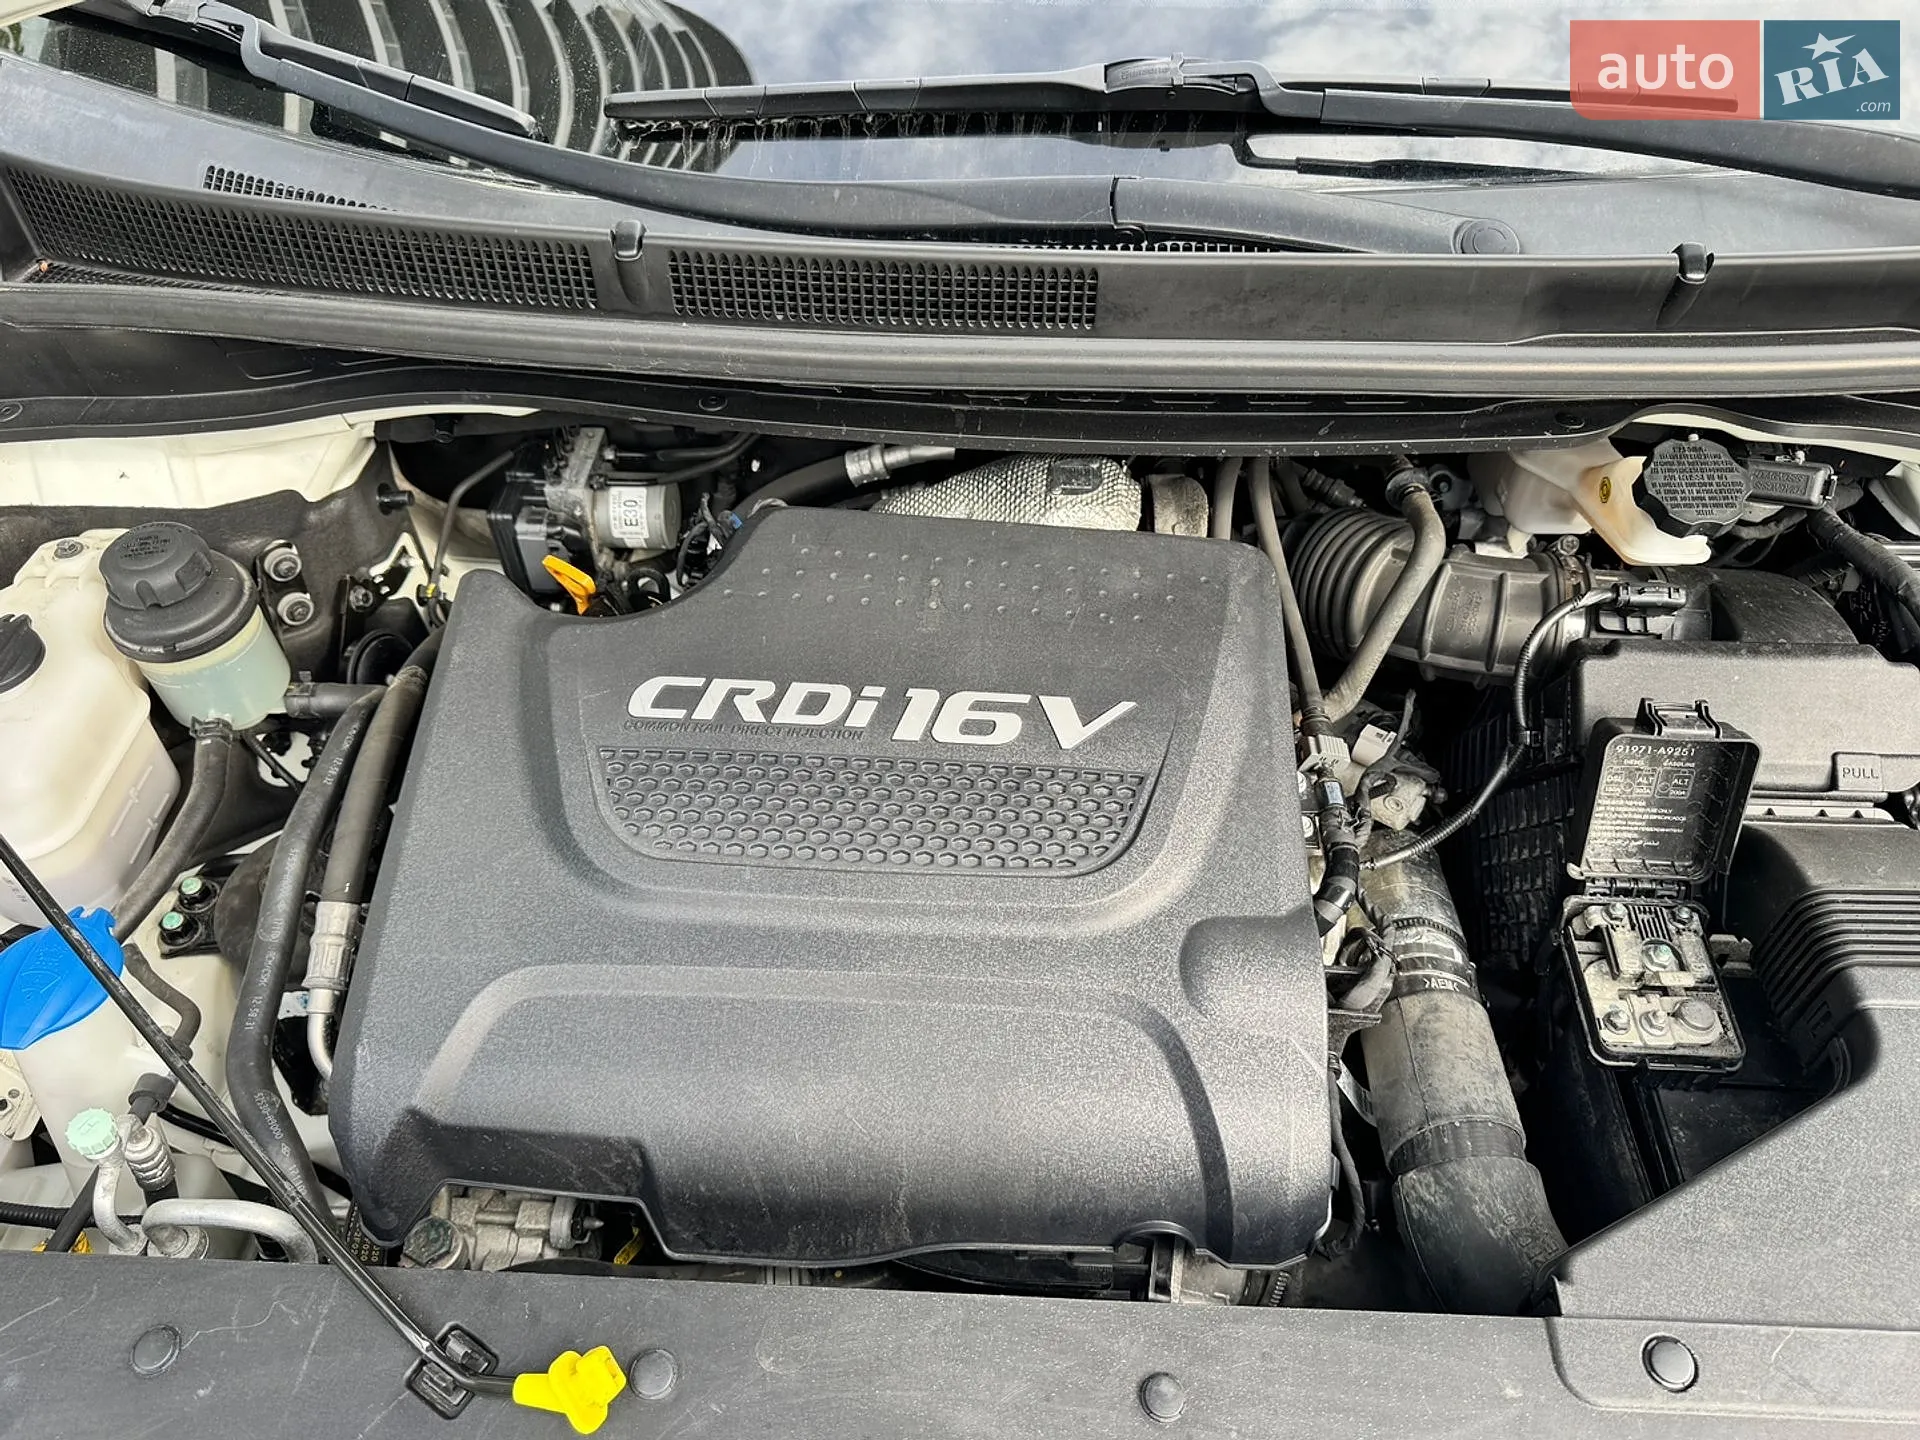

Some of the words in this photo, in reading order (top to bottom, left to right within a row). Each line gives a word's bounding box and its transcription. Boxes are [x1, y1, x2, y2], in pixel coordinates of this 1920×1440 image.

[627, 676, 887, 728] CRDi
[624, 719, 692, 732] COMMON
[1842, 767, 1880, 779] PULL
